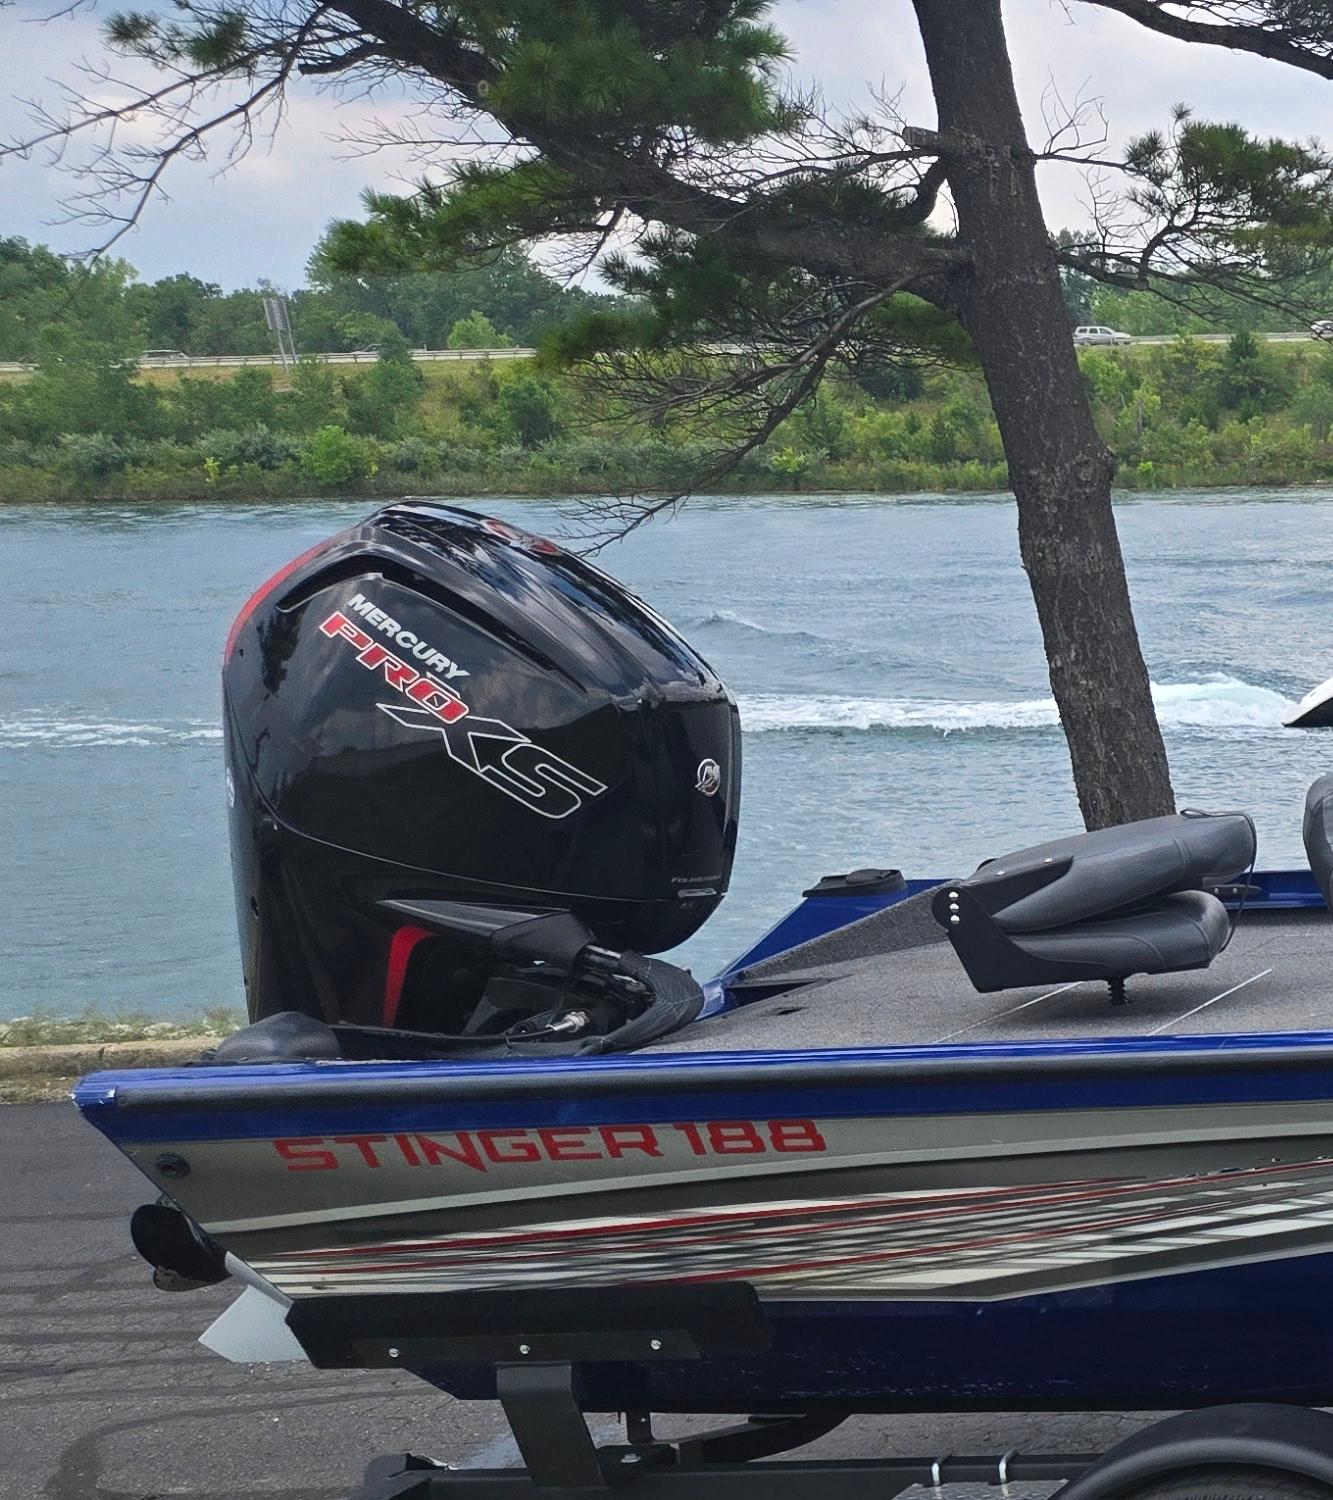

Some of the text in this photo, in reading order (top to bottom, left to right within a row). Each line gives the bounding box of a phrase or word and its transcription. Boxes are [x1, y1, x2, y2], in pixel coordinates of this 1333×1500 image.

[318, 611, 469, 724] PRO
[349, 593, 471, 679] MERCURY
[375, 702, 608, 819] XS
[272, 1119, 828, 1173] STINGER 188
